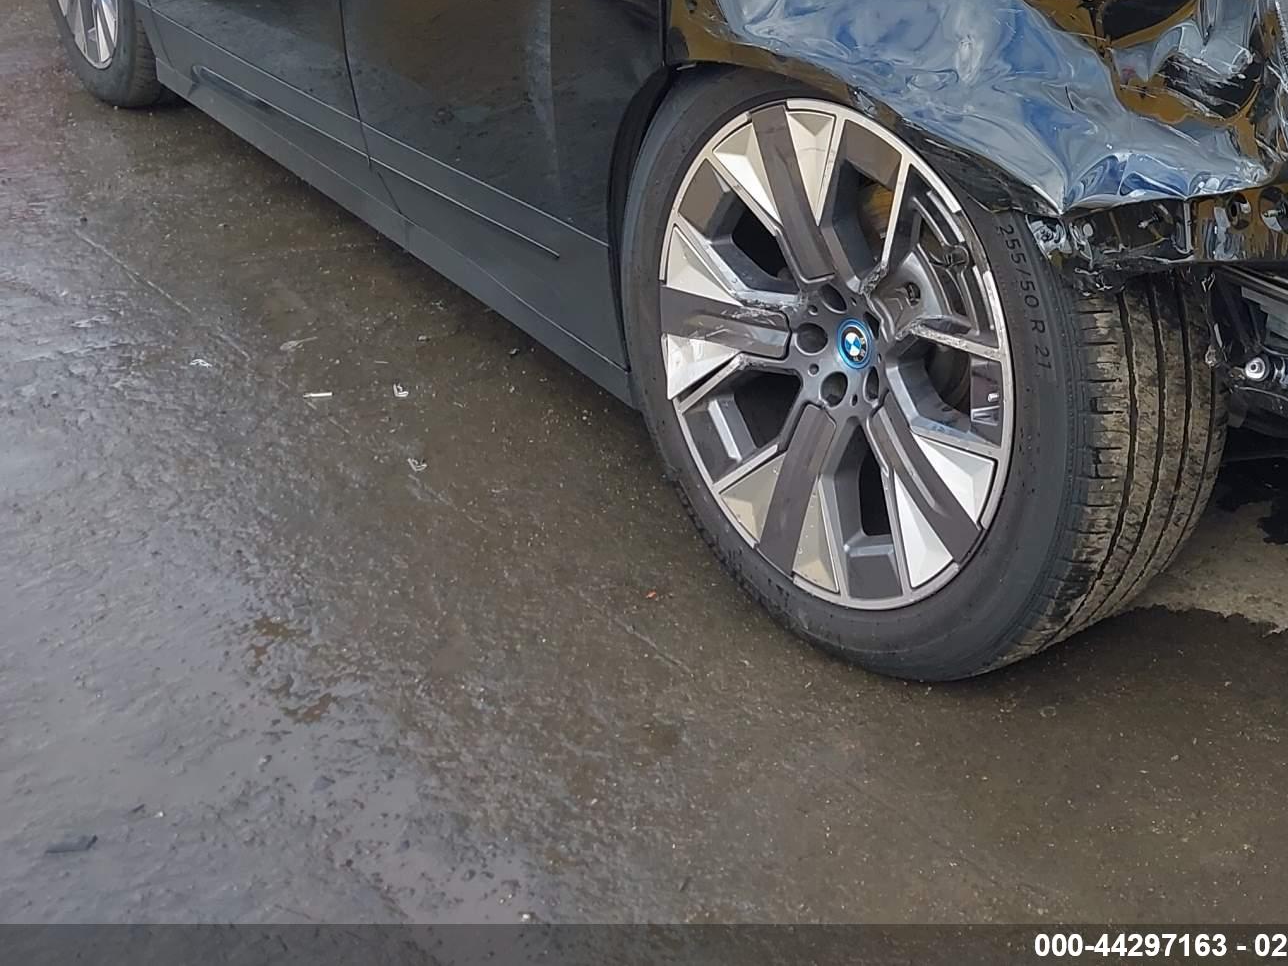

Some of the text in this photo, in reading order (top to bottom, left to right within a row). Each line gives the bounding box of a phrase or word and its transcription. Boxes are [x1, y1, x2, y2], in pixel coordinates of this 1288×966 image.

[999, 223, 1052, 370] 255/50 R 21
